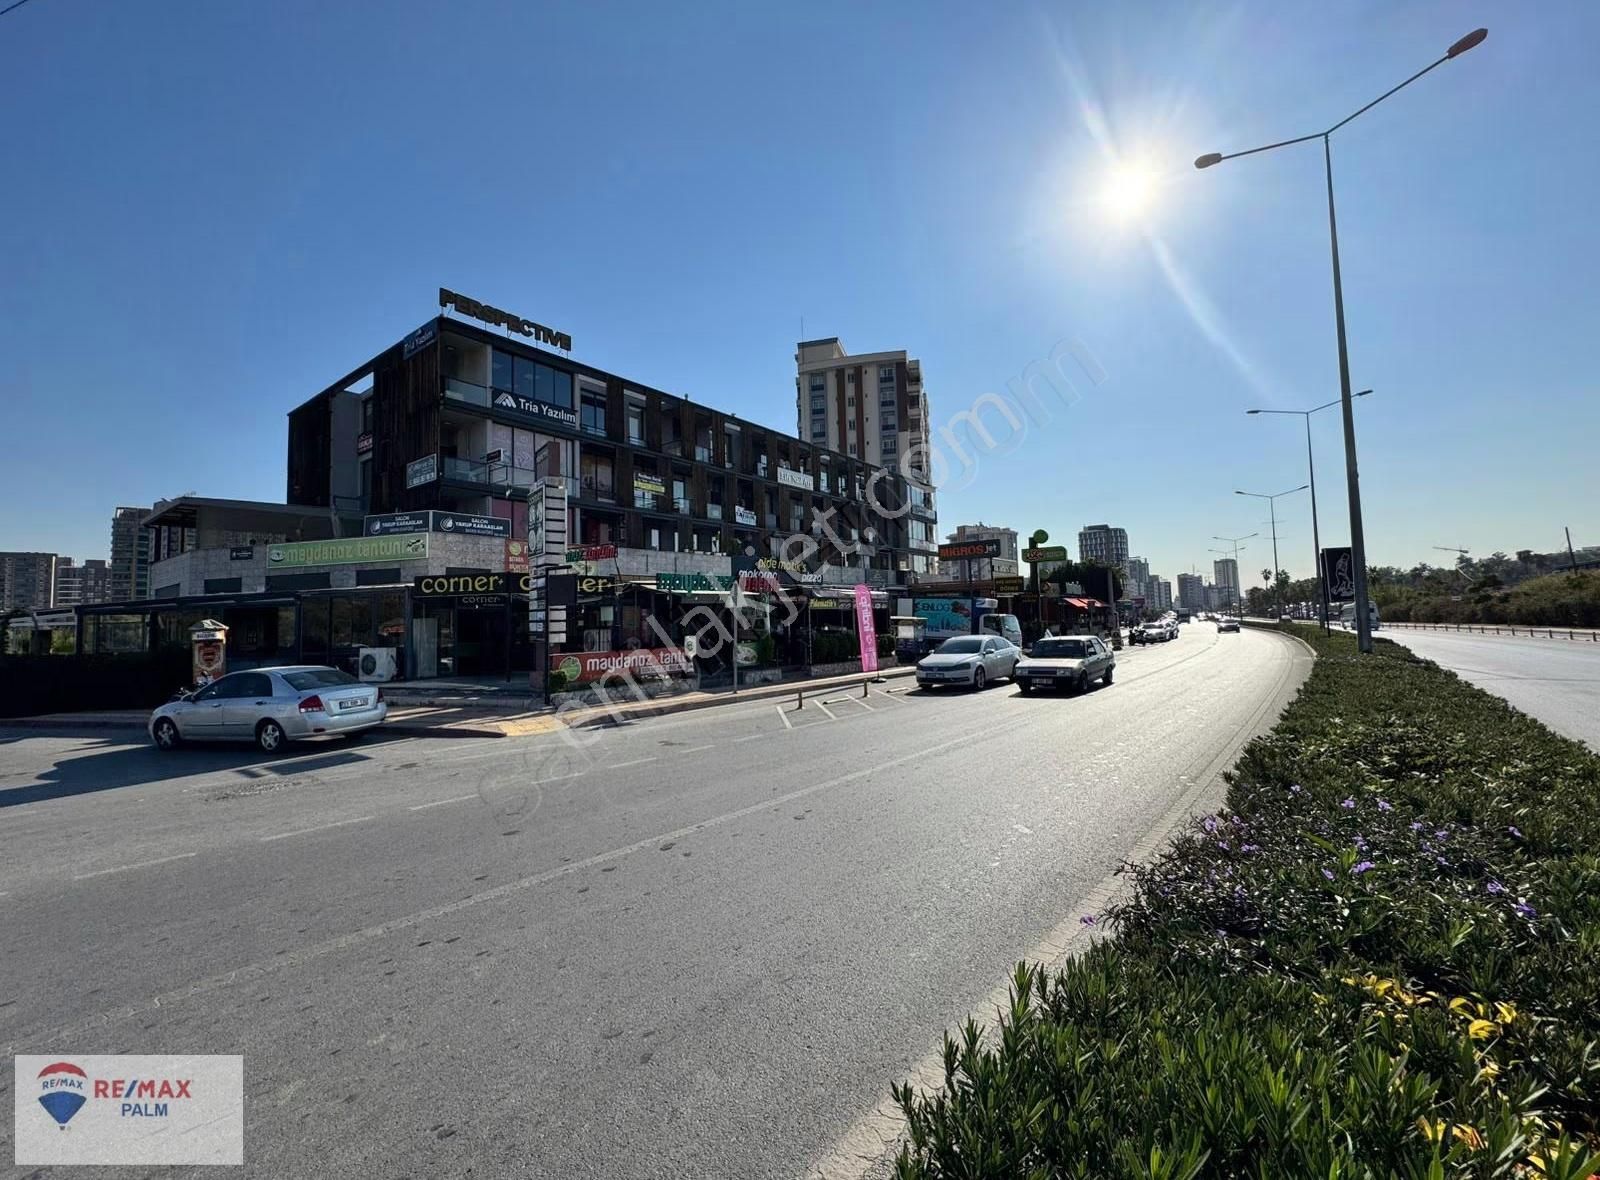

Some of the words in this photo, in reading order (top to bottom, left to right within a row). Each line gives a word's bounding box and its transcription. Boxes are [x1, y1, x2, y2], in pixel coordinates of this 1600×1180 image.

[439, 287, 572, 352] PERSPECTIVE
[518, 398, 539, 413] Tria
[587, 653, 652, 673] maydanoz
